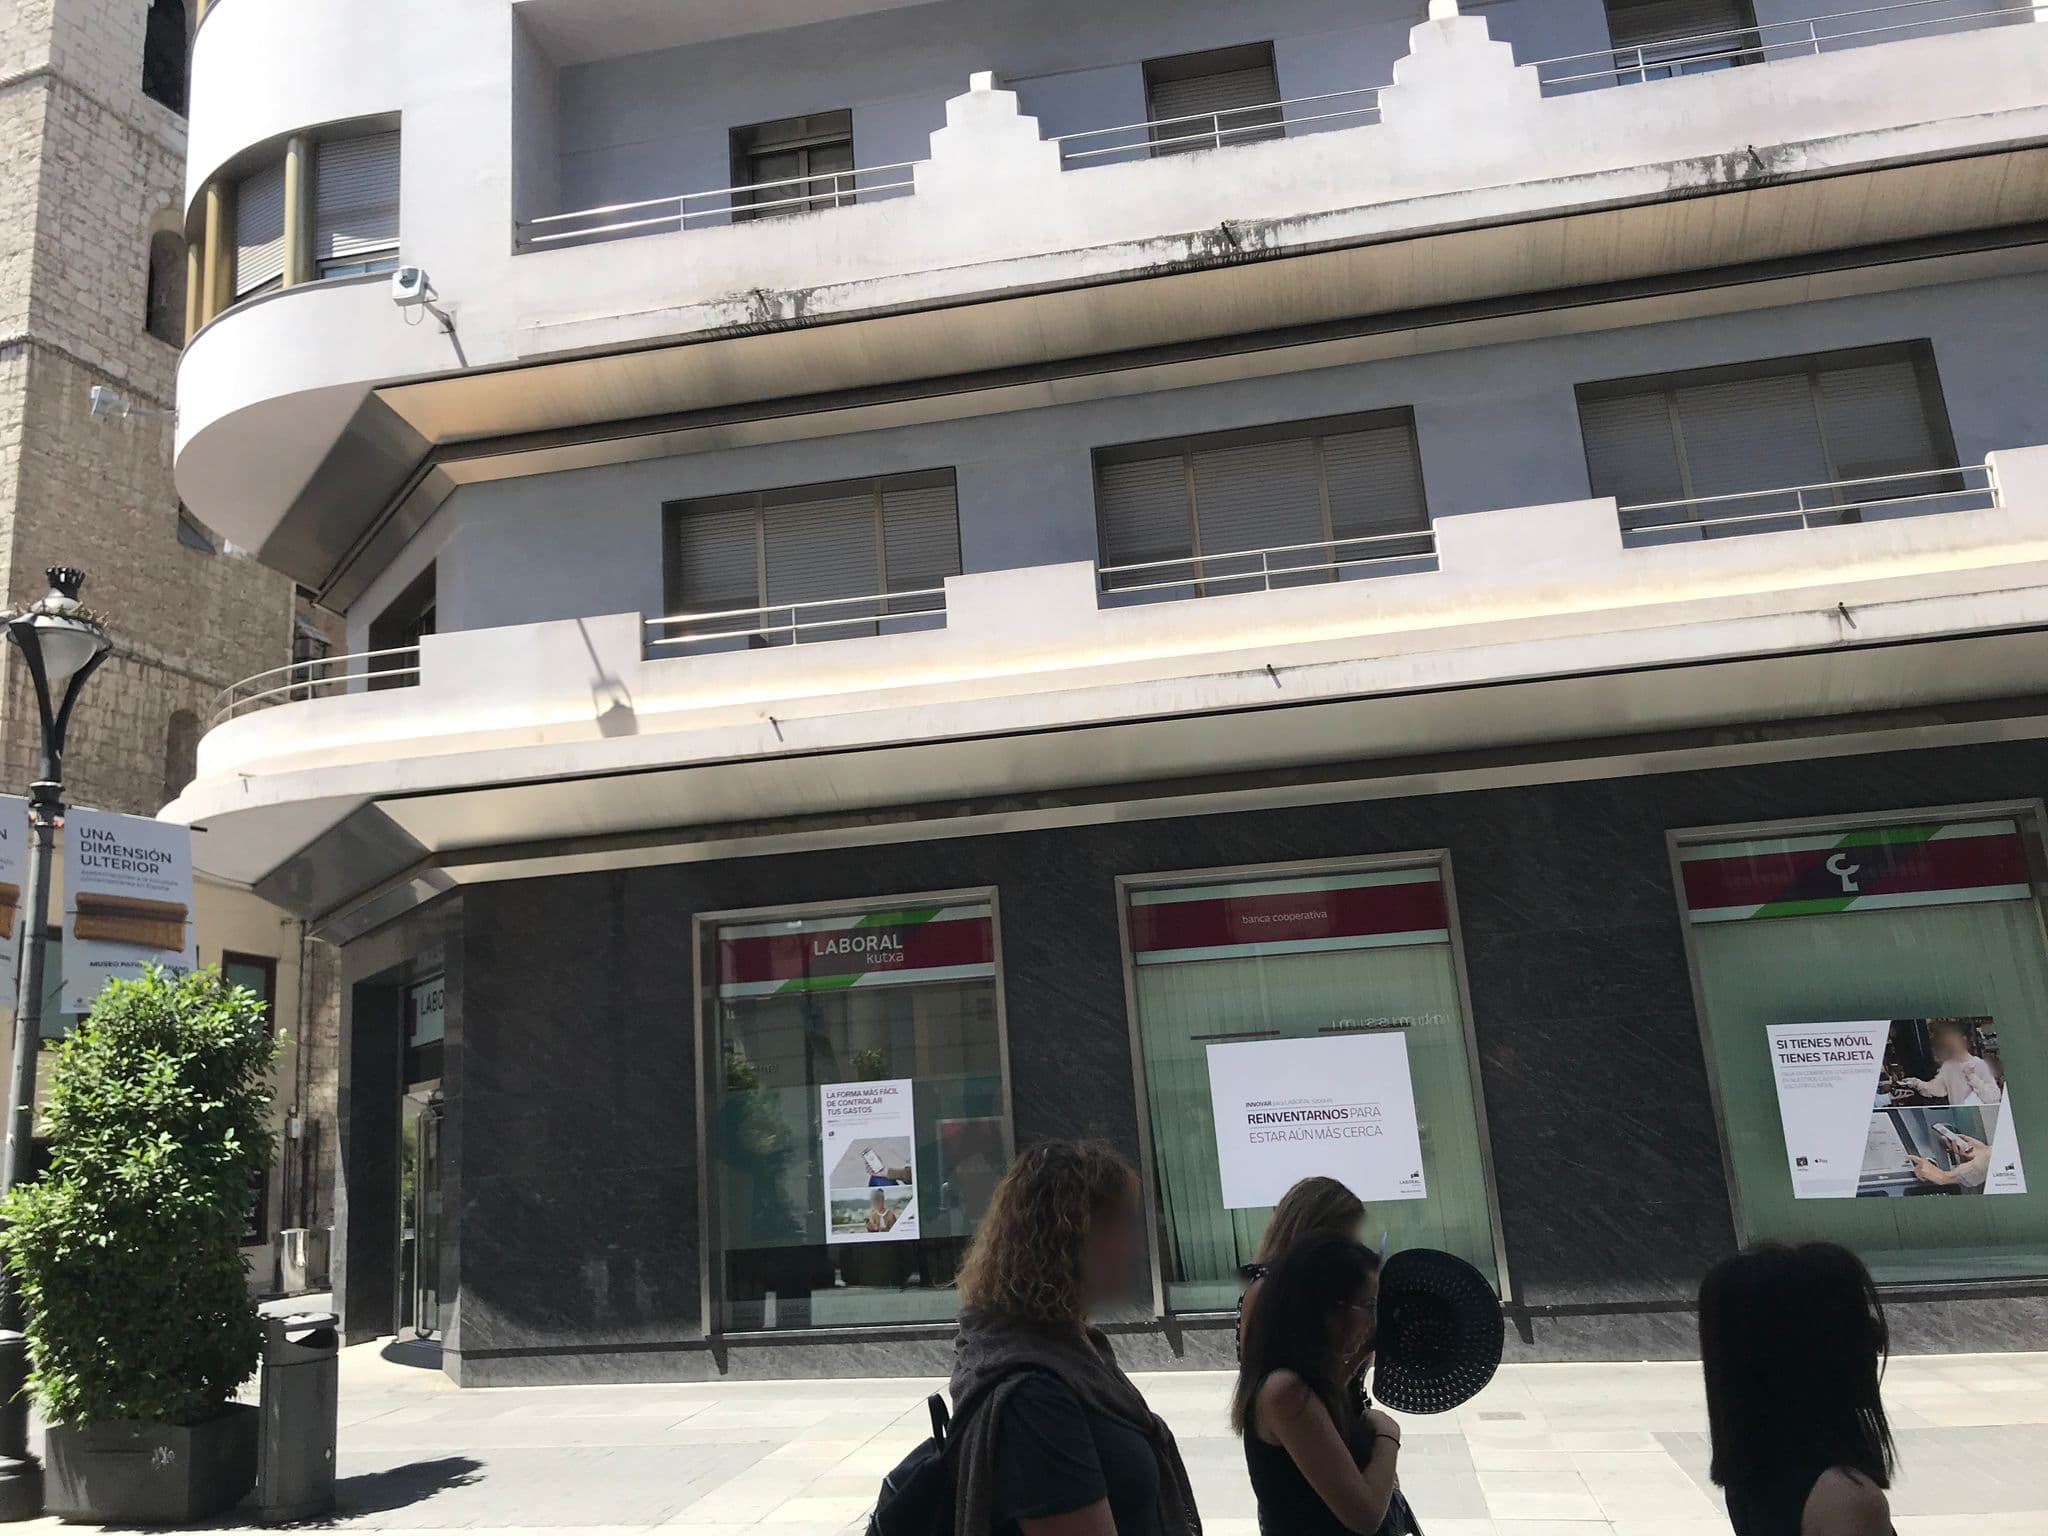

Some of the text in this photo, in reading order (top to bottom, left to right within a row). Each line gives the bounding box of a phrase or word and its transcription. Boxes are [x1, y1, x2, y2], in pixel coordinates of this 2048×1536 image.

[80, 827, 116, 842] UNA
[80, 841, 172, 864] DIMENSIÓN
[80, 854, 160, 875] ULTERIOR
[1242, 911, 1328, 924] banca cooperativa
[813, 934, 904, 956] LABORAL
[866, 952, 905, 964] kutxa
[1776, 1035, 1873, 1049] SI TIENES MÓVIL
[1779, 1051, 1874, 1063] TIENES TARJETA
[836, 1090, 862, 1098] FORMA
[838, 1097, 882, 1106] CONTROLAR
[843, 1106, 872, 1115] GASTOS
[1247, 1106, 1382, 1125] REINVENTARNOS PARA
[1249, 1125, 1384, 1143] ESTAR AÚN MÁS CERCA
